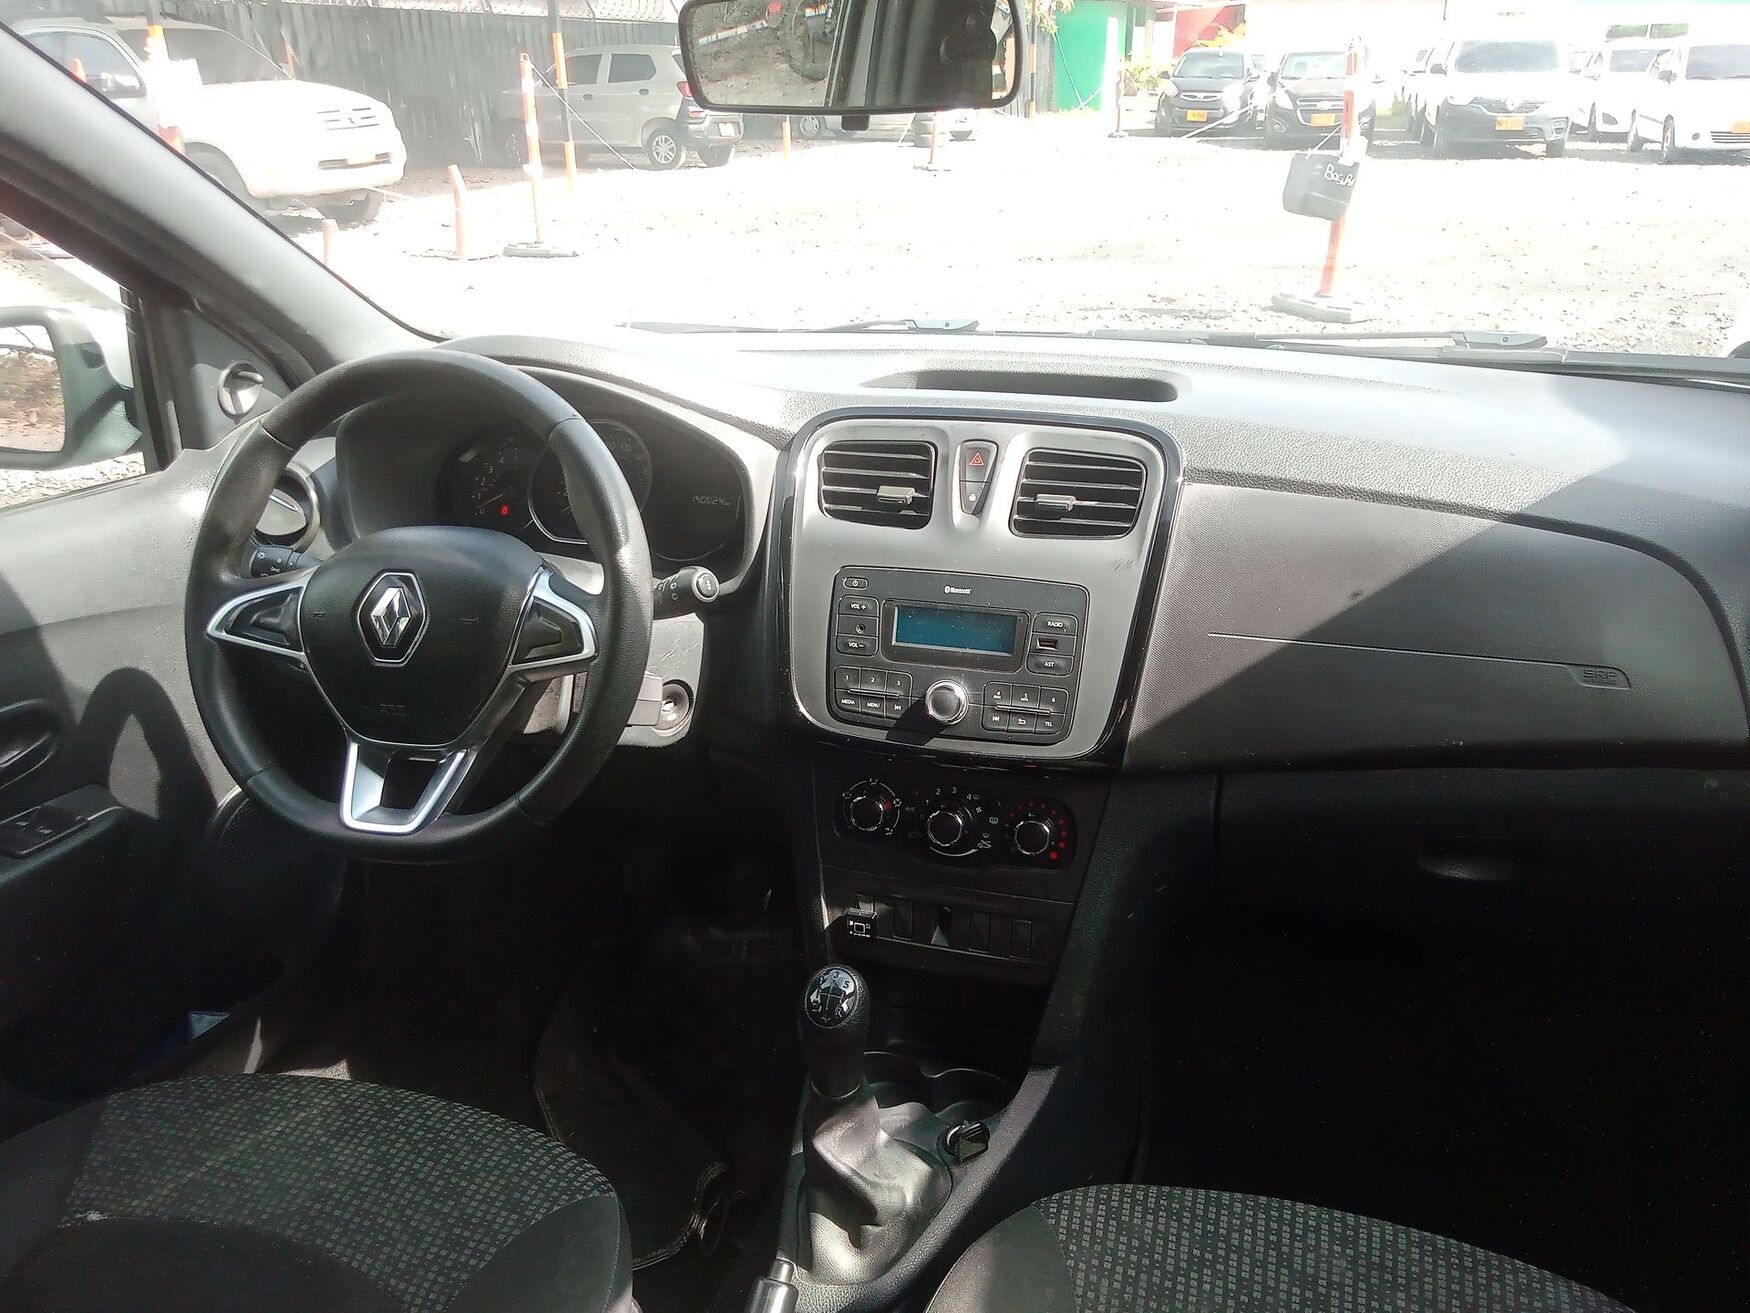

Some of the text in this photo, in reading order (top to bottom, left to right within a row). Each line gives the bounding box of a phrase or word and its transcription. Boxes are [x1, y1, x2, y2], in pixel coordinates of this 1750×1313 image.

[1047, 620, 1064, 628] RADIO
[848, 641, 858, 649] VOL
[1043, 660, 1055, 668] AST
[935, 788, 941, 796] 2
[952, 786, 957, 794] 3
[843, 980, 850, 989] 5
